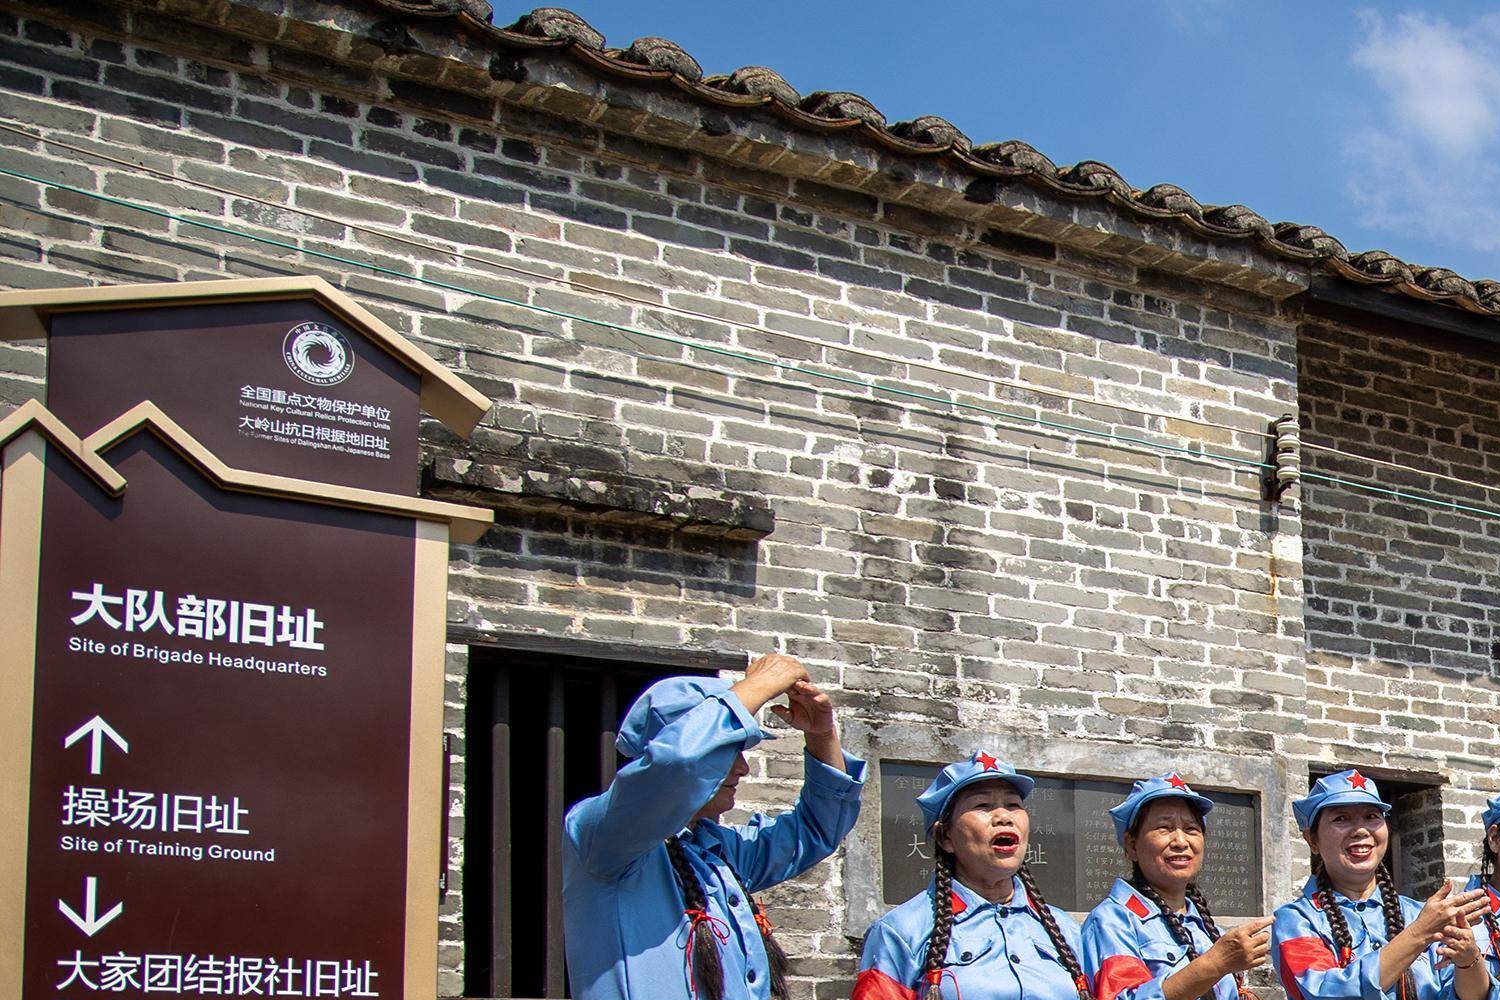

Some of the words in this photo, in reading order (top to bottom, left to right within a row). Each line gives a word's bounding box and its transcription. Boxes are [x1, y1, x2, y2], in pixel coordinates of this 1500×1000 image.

[240, 384, 391, 422] 全国重点文物保护单位
[240, 399, 269, 411] National
[270, 404, 284, 414] Key
[286, 407, 313, 418] Cultural
[314, 412, 336, 421] Relics
[337, 415, 372, 427] Protection
[373, 421, 391, 431] Units
[239, 415, 390, 451] 大岭山抗日根据地旧址
[273, 435, 290, 444] Sites
[297, 439, 331, 450] Dalingshan
[332, 444, 375, 456] Anti-Japanese
[375, 450, 391, 460] Base
[71, 583, 325, 651] 大队部旧址
[69, 637, 105, 654] Site
[111, 642, 129, 656] of
[133, 644, 203, 664] Brigade
[208, 652, 327, 677] Headquarters
[62, 785, 249, 835] 操场旧址
[61, 836, 99, 852] Site
[104, 839, 123, 853] of
[127, 839, 203, 860] Training
[208, 845, 275, 862] Ground
[907, 833, 932, 860] 大
[56, 950, 379, 997] 大家团结报社旧址
